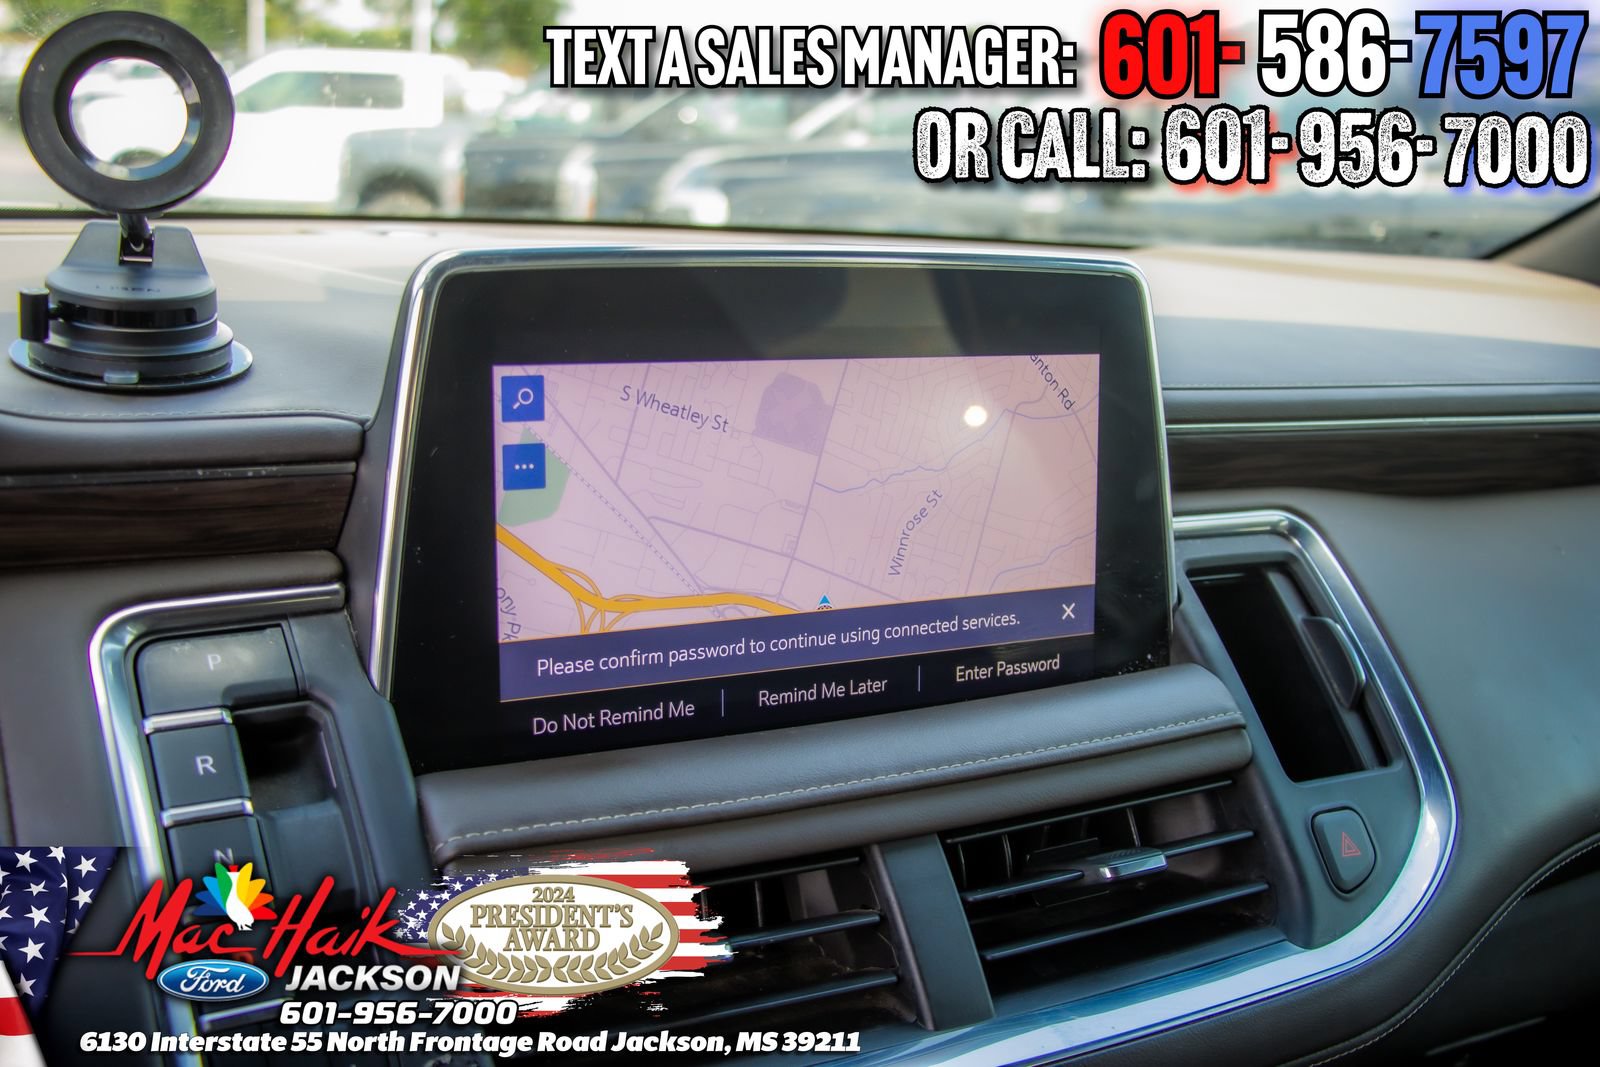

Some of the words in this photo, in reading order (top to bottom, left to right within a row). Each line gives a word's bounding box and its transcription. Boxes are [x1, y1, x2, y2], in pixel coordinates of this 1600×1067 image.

[620, 385, 632, 401] S
[636, 389, 709, 430] Wheatley
[711, 415, 729, 432] St
[1057, 388, 1076, 410] Rd
[888, 507, 928, 576] Winnrose
[926, 489, 943, 508] St
[537, 657, 594, 677] Please
[599, 648, 663, 670] confirm
[669, 638, 745, 667] password
[749, 639, 766, 653] to
[770, 633, 836, 651] continue
[841, 627, 880, 645] using
[884, 616, 958, 639] connected
[962, 612, 1020, 630] services.
[207, 653, 222, 671] P
[956, 665, 993, 682] Enter
[997, 654, 1060, 676] Password
[759, 684, 817, 707] Remind
[822, 681, 845, 699] Me
[850, 678, 887, 695] Later
[533, 717, 557, 735] Do
[563, 713, 595, 731] Not
[600, 703, 663, 727] Remind
[669, 700, 695, 719] Me
[196, 755, 217, 775] R
[213, 847, 235, 865] N
